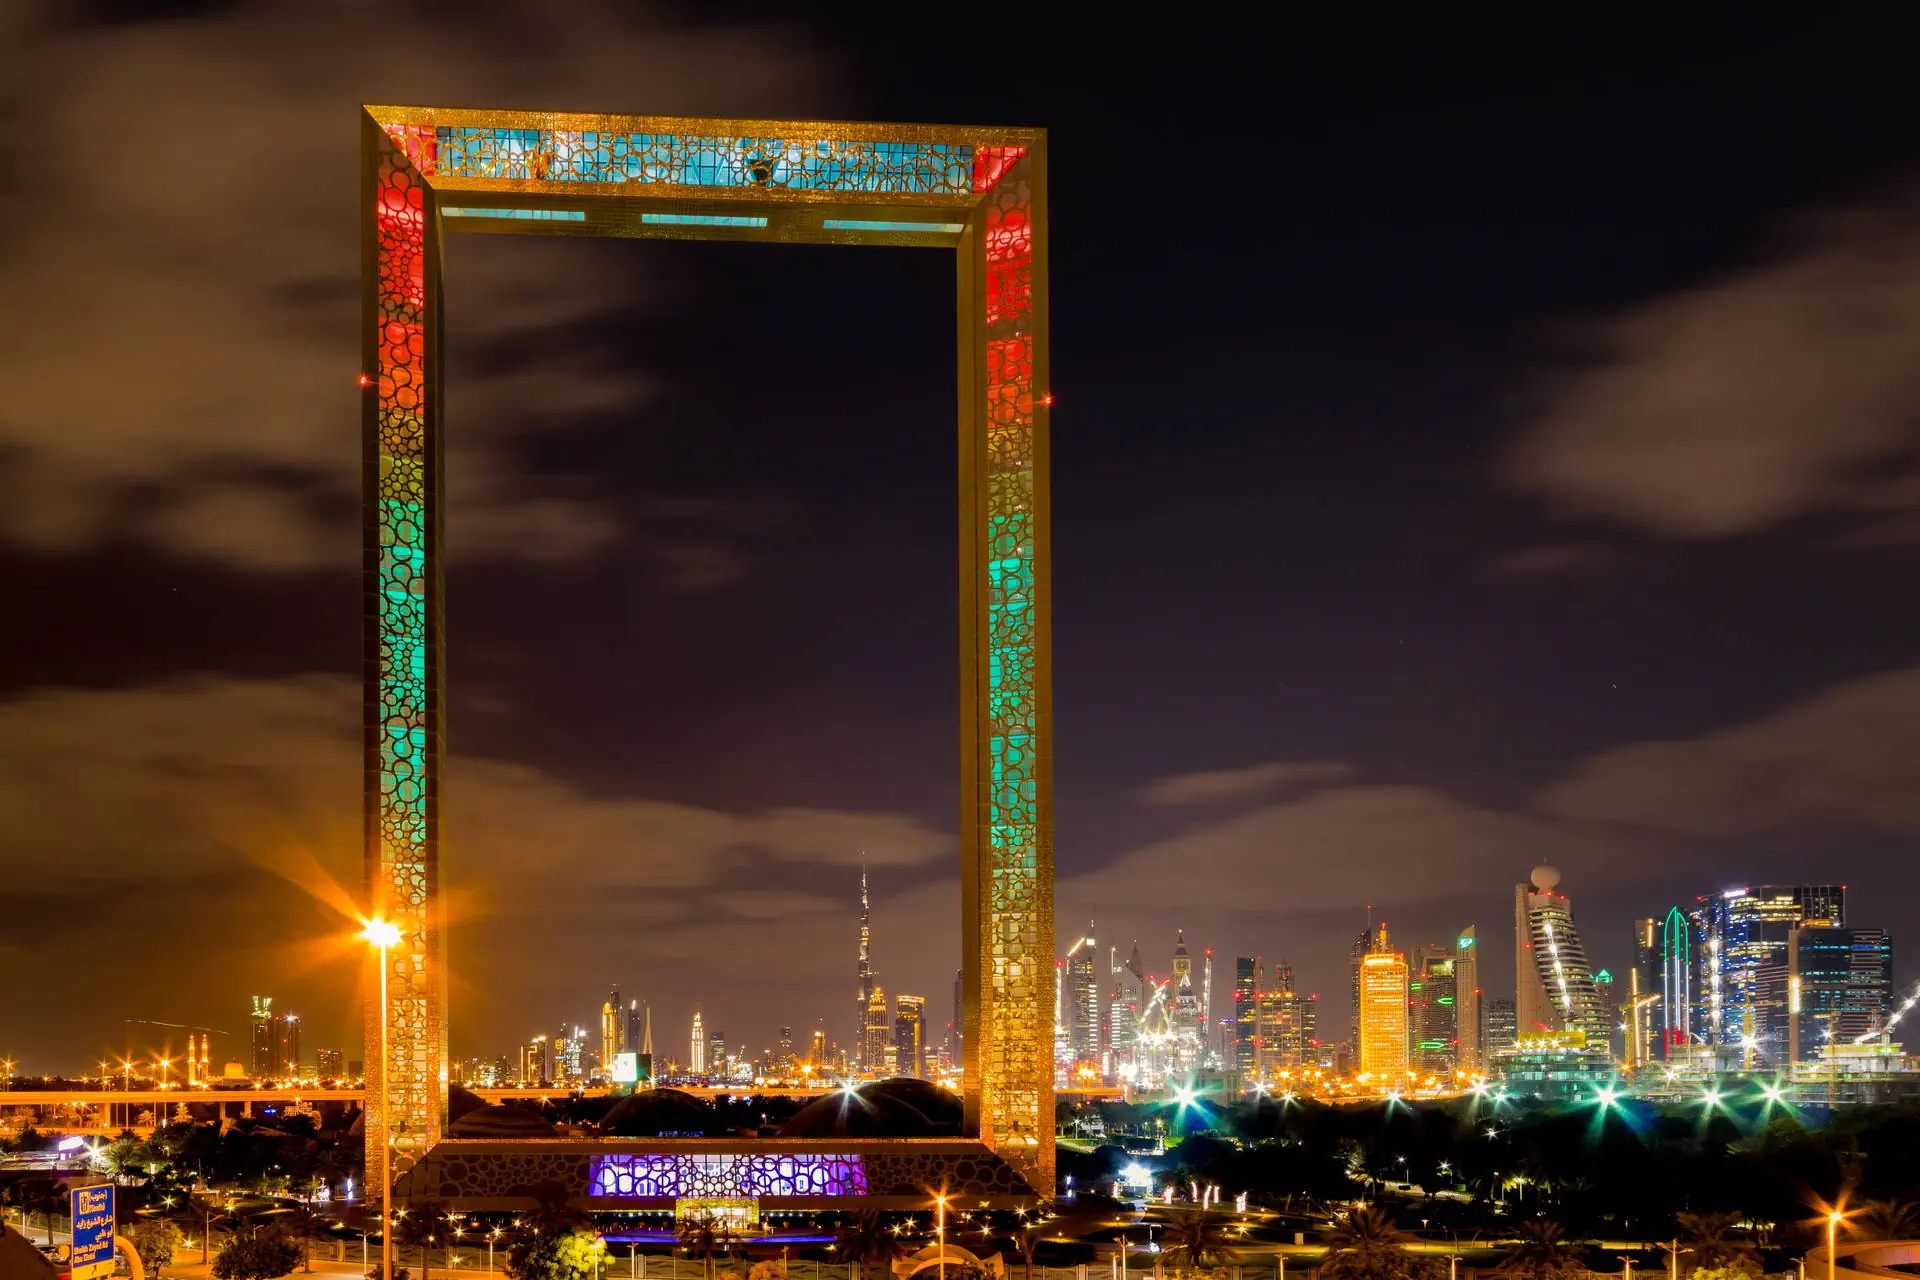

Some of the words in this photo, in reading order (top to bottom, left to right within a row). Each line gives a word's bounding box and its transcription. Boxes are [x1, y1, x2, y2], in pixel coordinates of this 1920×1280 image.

[76, 1218, 87, 1230] زايد
[87, 1216, 101, 1229] الشيخ
[101, 1215, 113, 1227] شارع
